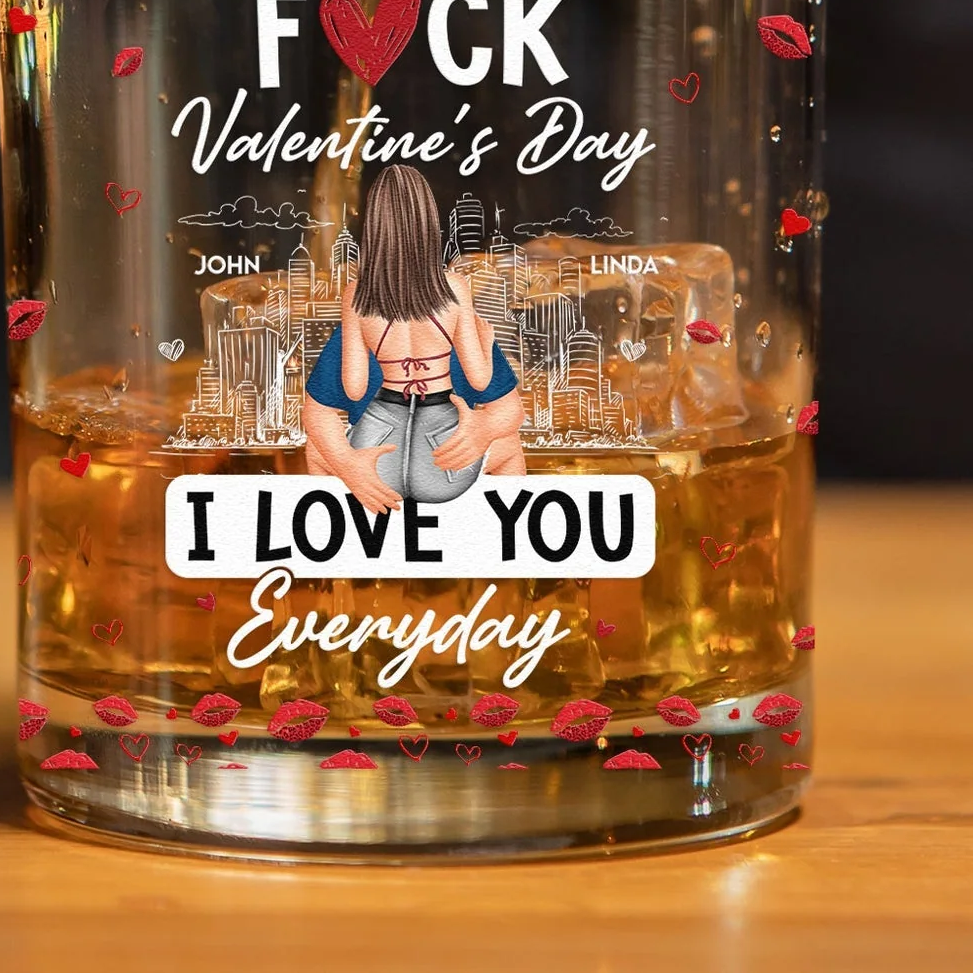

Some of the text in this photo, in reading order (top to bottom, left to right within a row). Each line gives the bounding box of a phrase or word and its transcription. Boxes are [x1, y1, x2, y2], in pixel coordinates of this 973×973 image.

[171, 87, 656, 192] Valentine's Day
[194, 254, 261, 276] JOHN
[590, 254, 660, 276] LINDA
[186, 489, 635, 563] I LOVE YOU
[227, 568, 571, 689] Everyday
